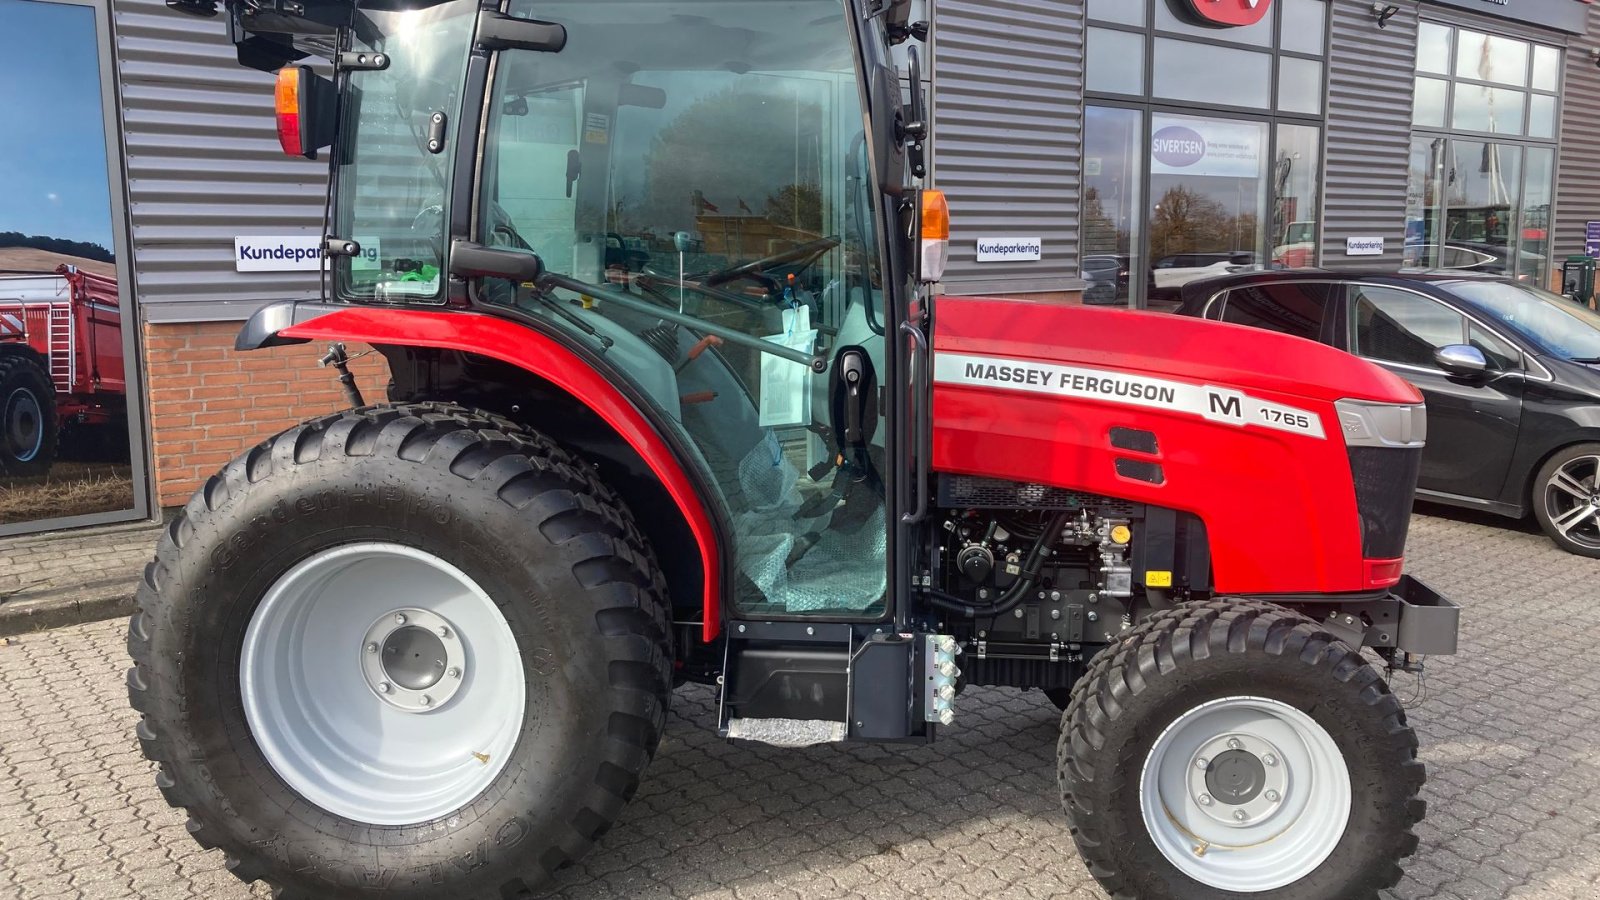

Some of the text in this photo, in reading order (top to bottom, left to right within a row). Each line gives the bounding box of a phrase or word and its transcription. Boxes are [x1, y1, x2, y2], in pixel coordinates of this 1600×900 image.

[1153, 138, 1202, 154] SIVERTSEN
[979, 243, 1040, 256] Kundeparkering
[965, 362, 1309, 428] MASSEY FERGUSON M 1765
